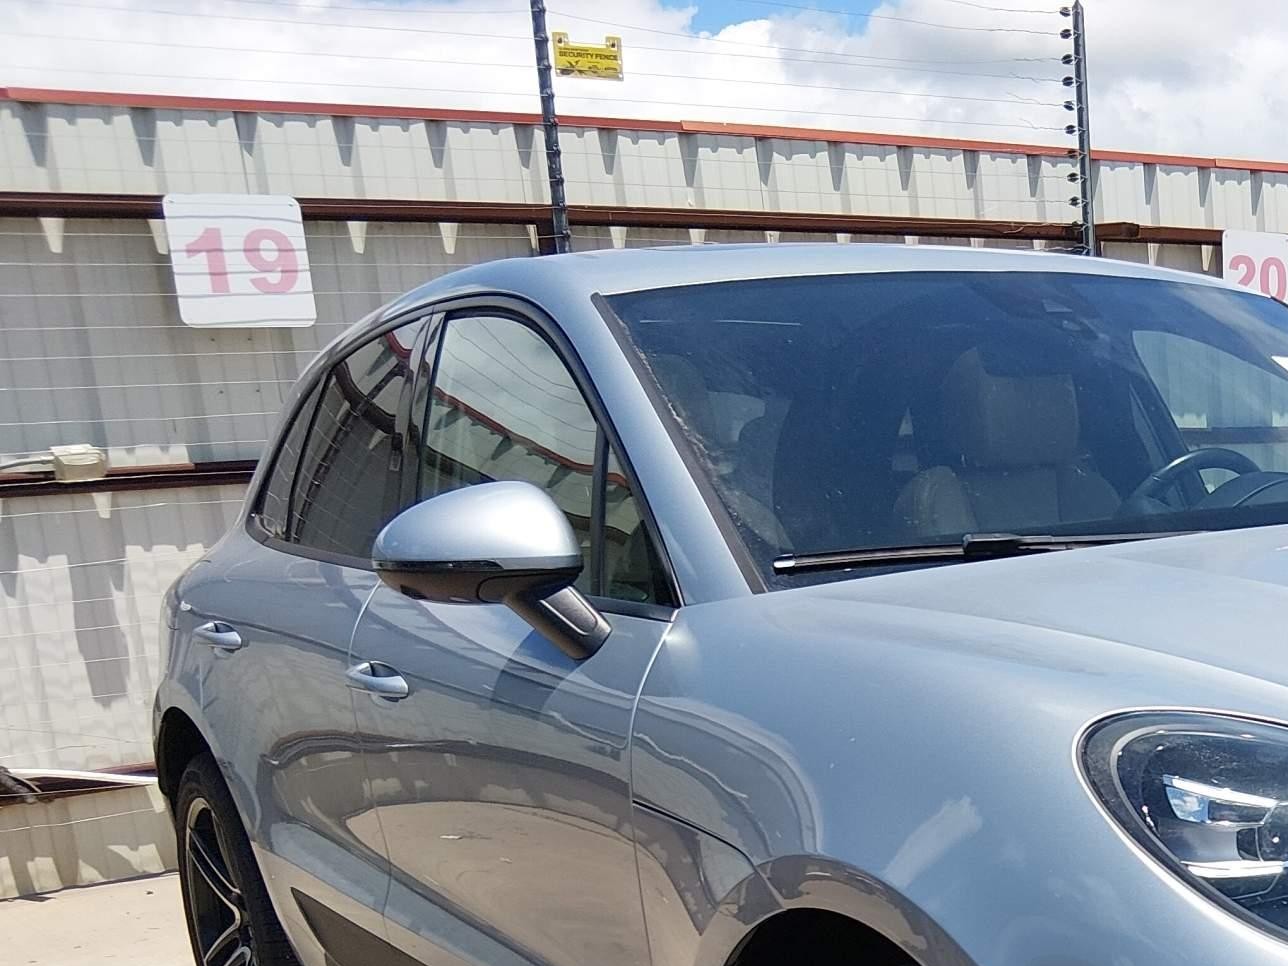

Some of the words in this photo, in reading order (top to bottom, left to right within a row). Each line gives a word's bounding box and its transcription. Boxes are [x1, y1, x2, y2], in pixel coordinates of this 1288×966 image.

[559, 51, 594, 60] SECURITY
[595, 53, 618, 61] FENCE
[185, 228, 299, 294] 19
[1230, 255, 1287, 302] 20
